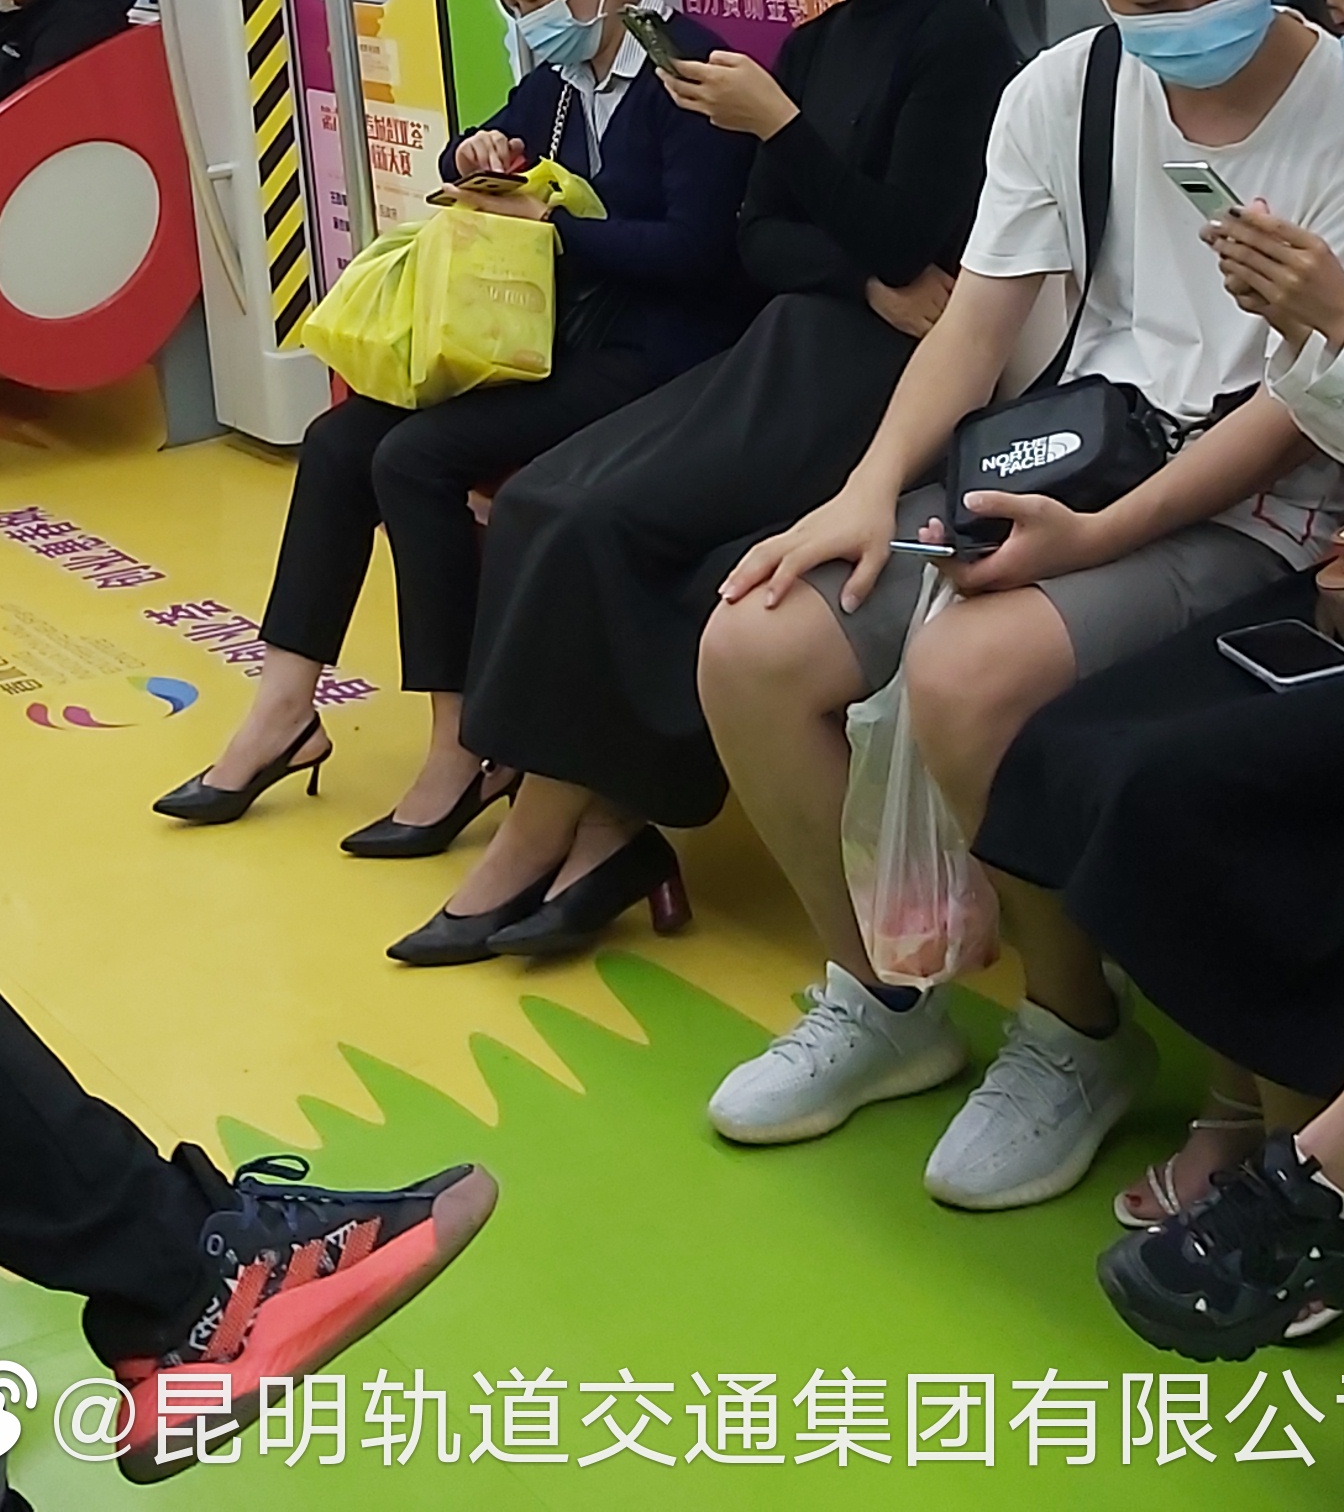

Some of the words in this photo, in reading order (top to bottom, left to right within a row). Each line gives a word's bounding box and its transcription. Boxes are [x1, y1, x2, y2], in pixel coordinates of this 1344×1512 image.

[1010, 436, 1047, 453] THE
[981, 445, 1046, 473] NORTH
[999, 454, 1047, 478] FACE
